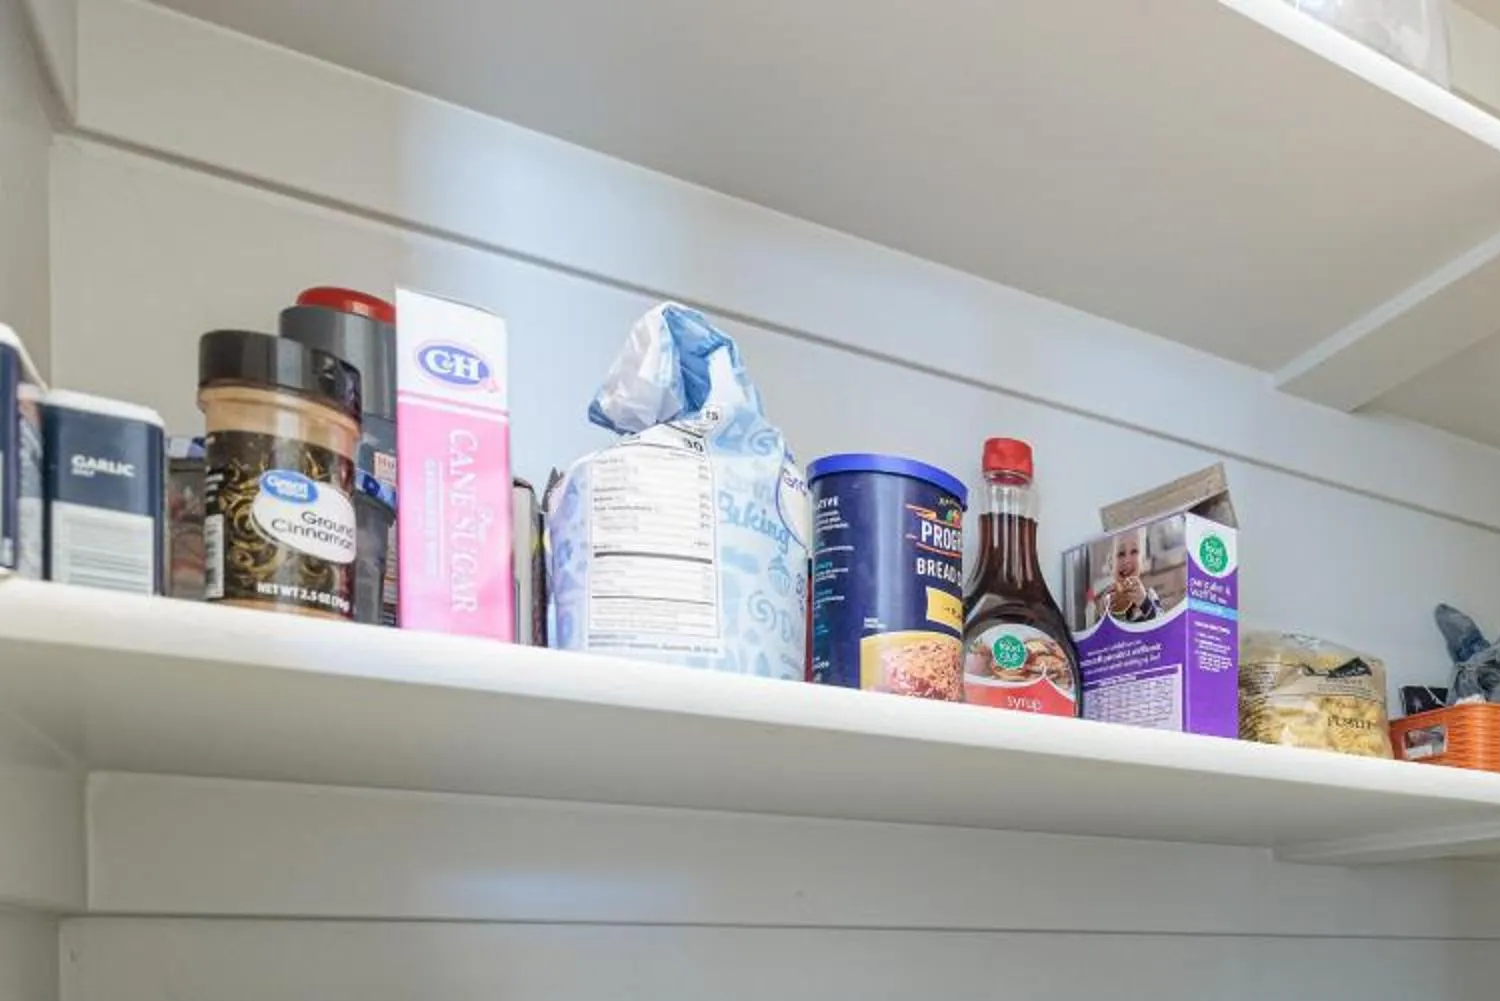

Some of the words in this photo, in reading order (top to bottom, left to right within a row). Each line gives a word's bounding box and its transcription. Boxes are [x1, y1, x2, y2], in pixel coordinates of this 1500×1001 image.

[424, 348, 482, 382] C&H
[71, 454, 135, 477] GARLIC
[449, 428, 479, 510] CANE
[450, 514, 479, 614] SUGAR
[916, 557, 956, 583] BREAD
